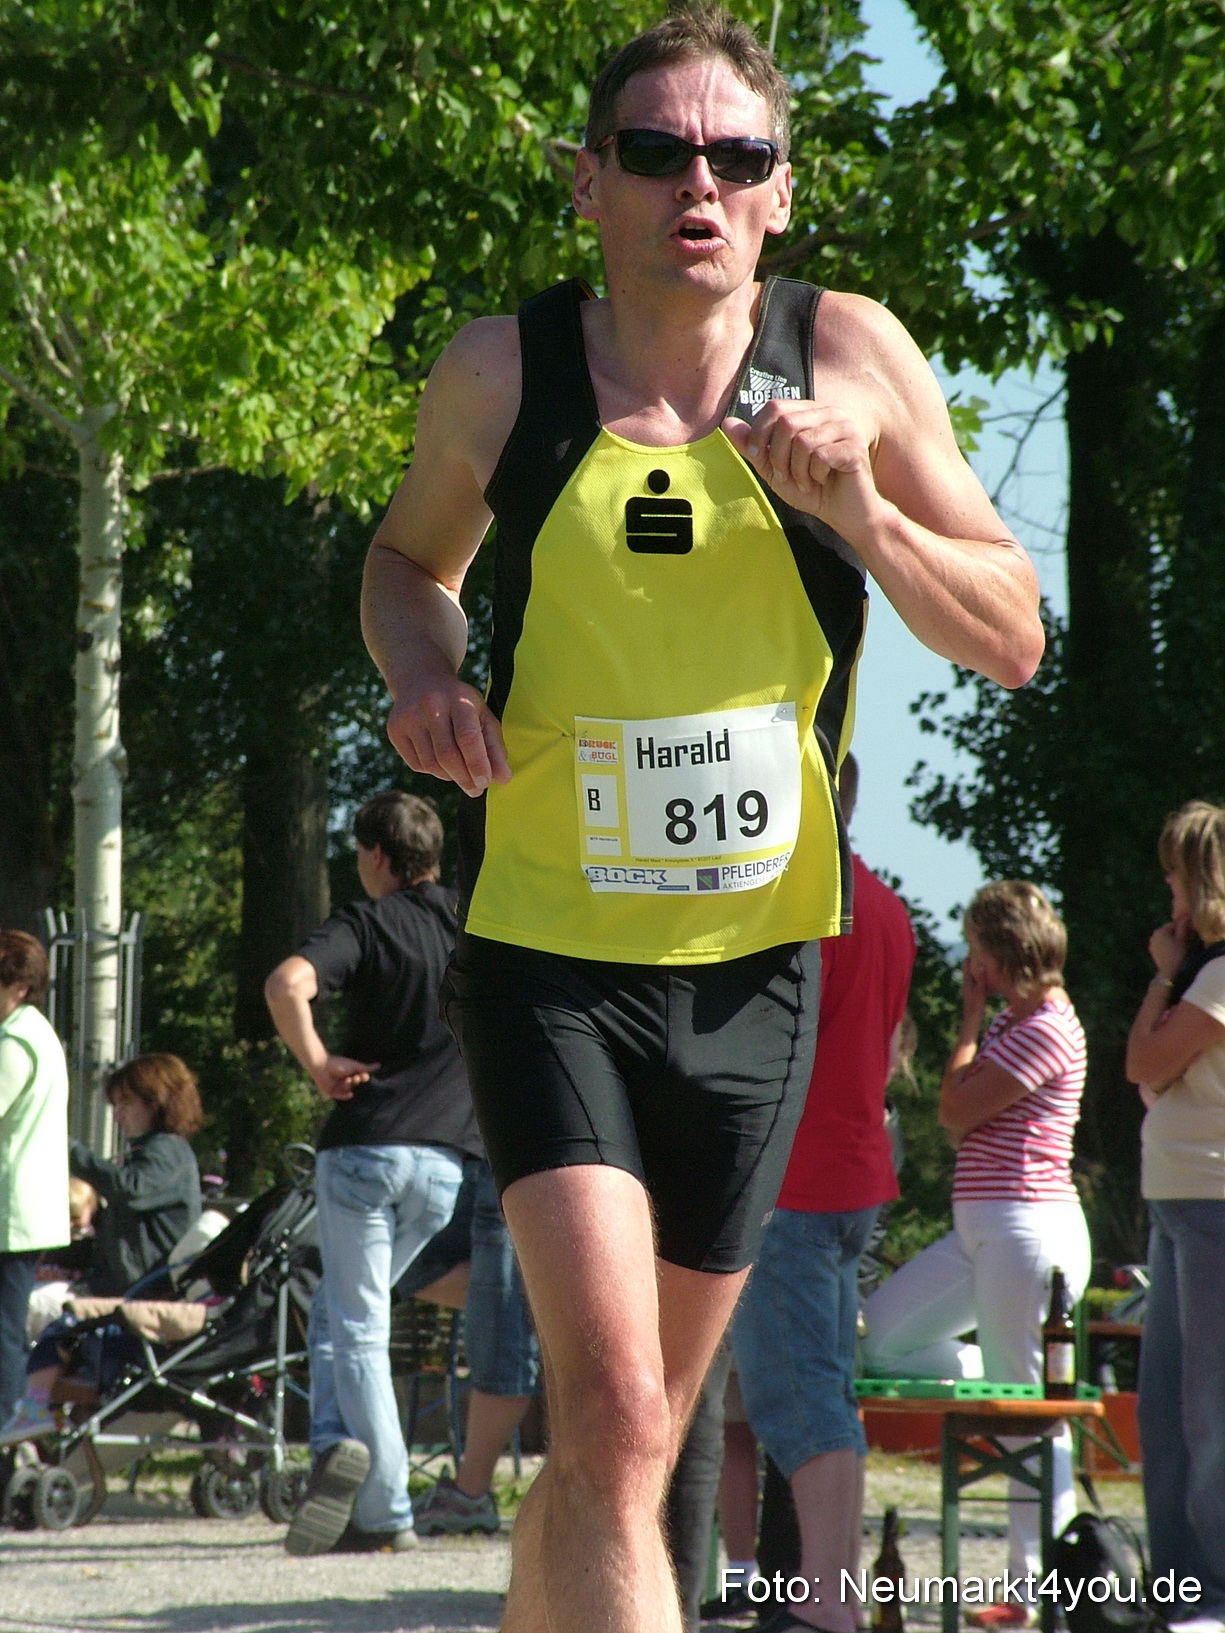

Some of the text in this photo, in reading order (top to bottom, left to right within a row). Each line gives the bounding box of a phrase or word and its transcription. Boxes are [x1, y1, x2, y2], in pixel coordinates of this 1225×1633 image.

[739, 386, 801, 404] BLOEMEN
[635, 728, 731, 770] Harald
[587, 788, 601, 811] B
[664, 789, 769, 846] 819
[585, 866, 667, 885] BOCK
